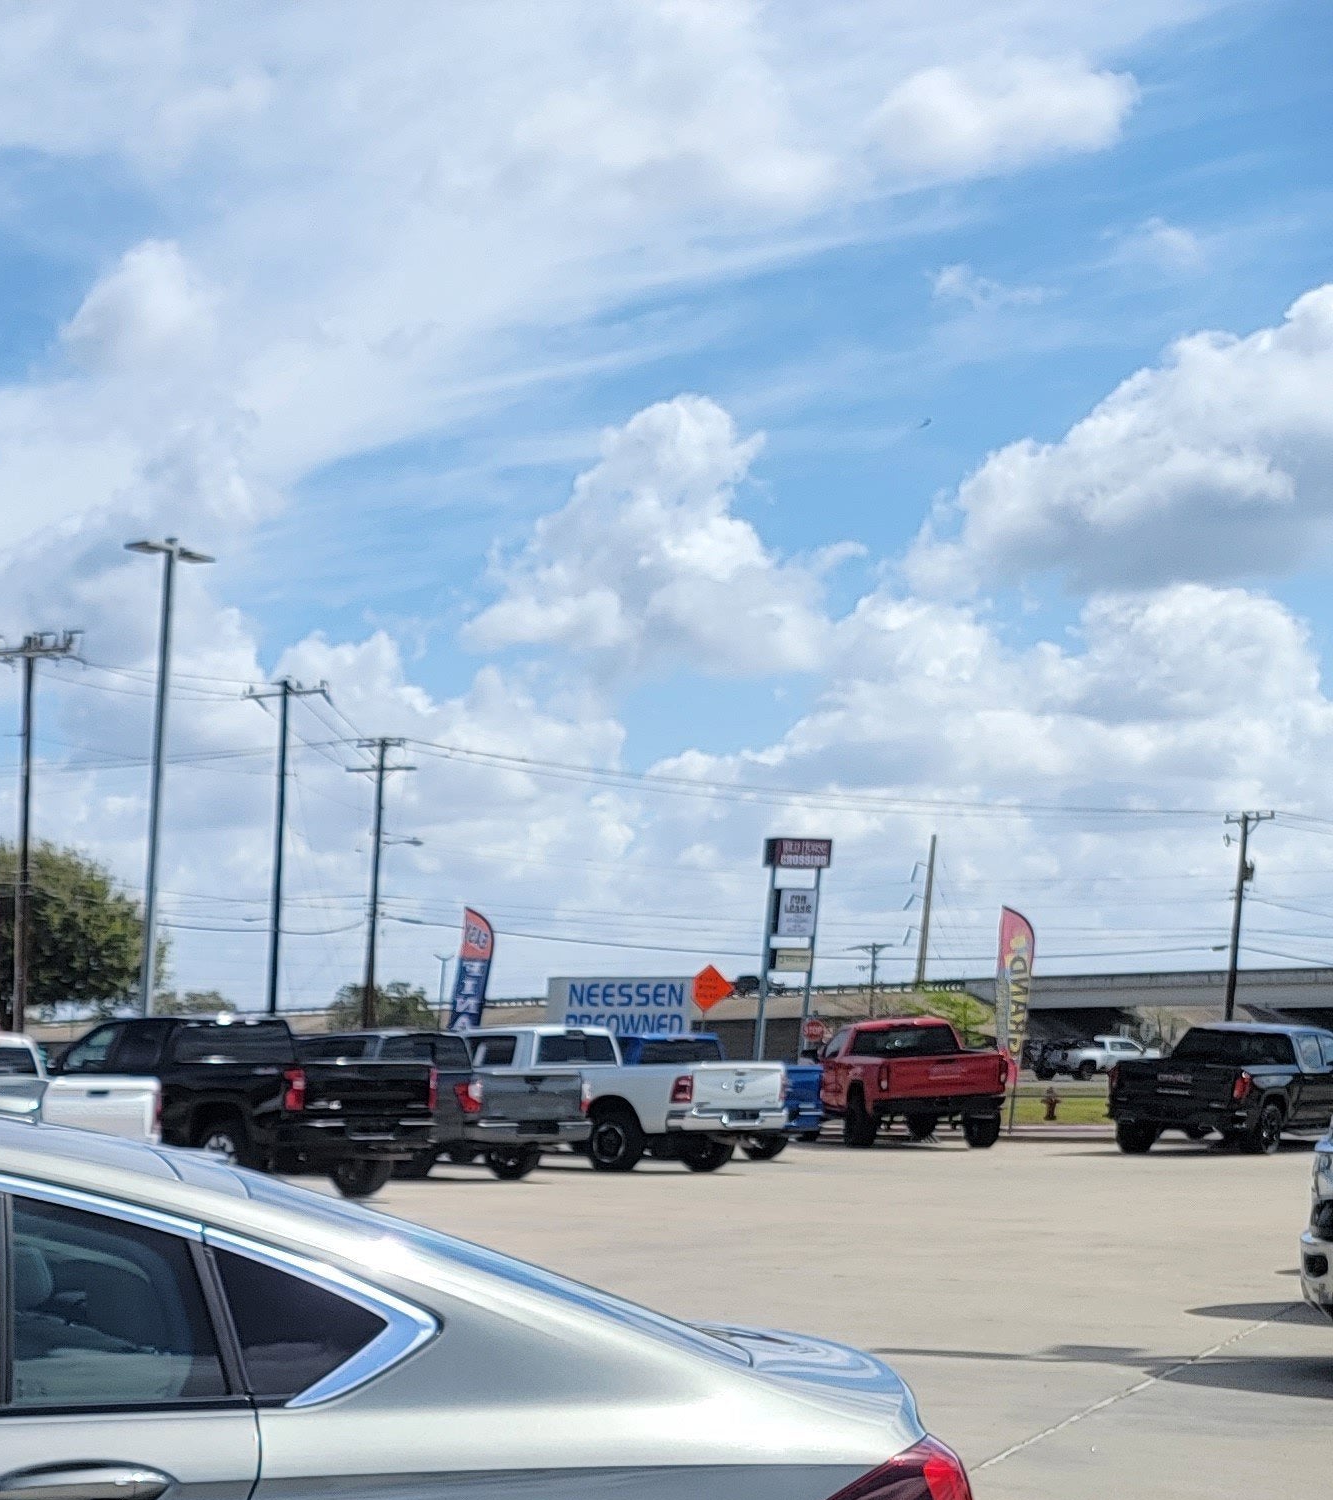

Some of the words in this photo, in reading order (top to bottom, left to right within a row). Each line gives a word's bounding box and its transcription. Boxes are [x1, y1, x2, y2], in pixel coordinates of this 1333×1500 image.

[789, 895, 807, 904] FOR
[784, 904, 812, 914] LEASE
[568, 983, 684, 1007] NEESSEN
[803, 1024, 823, 1035] STOP
